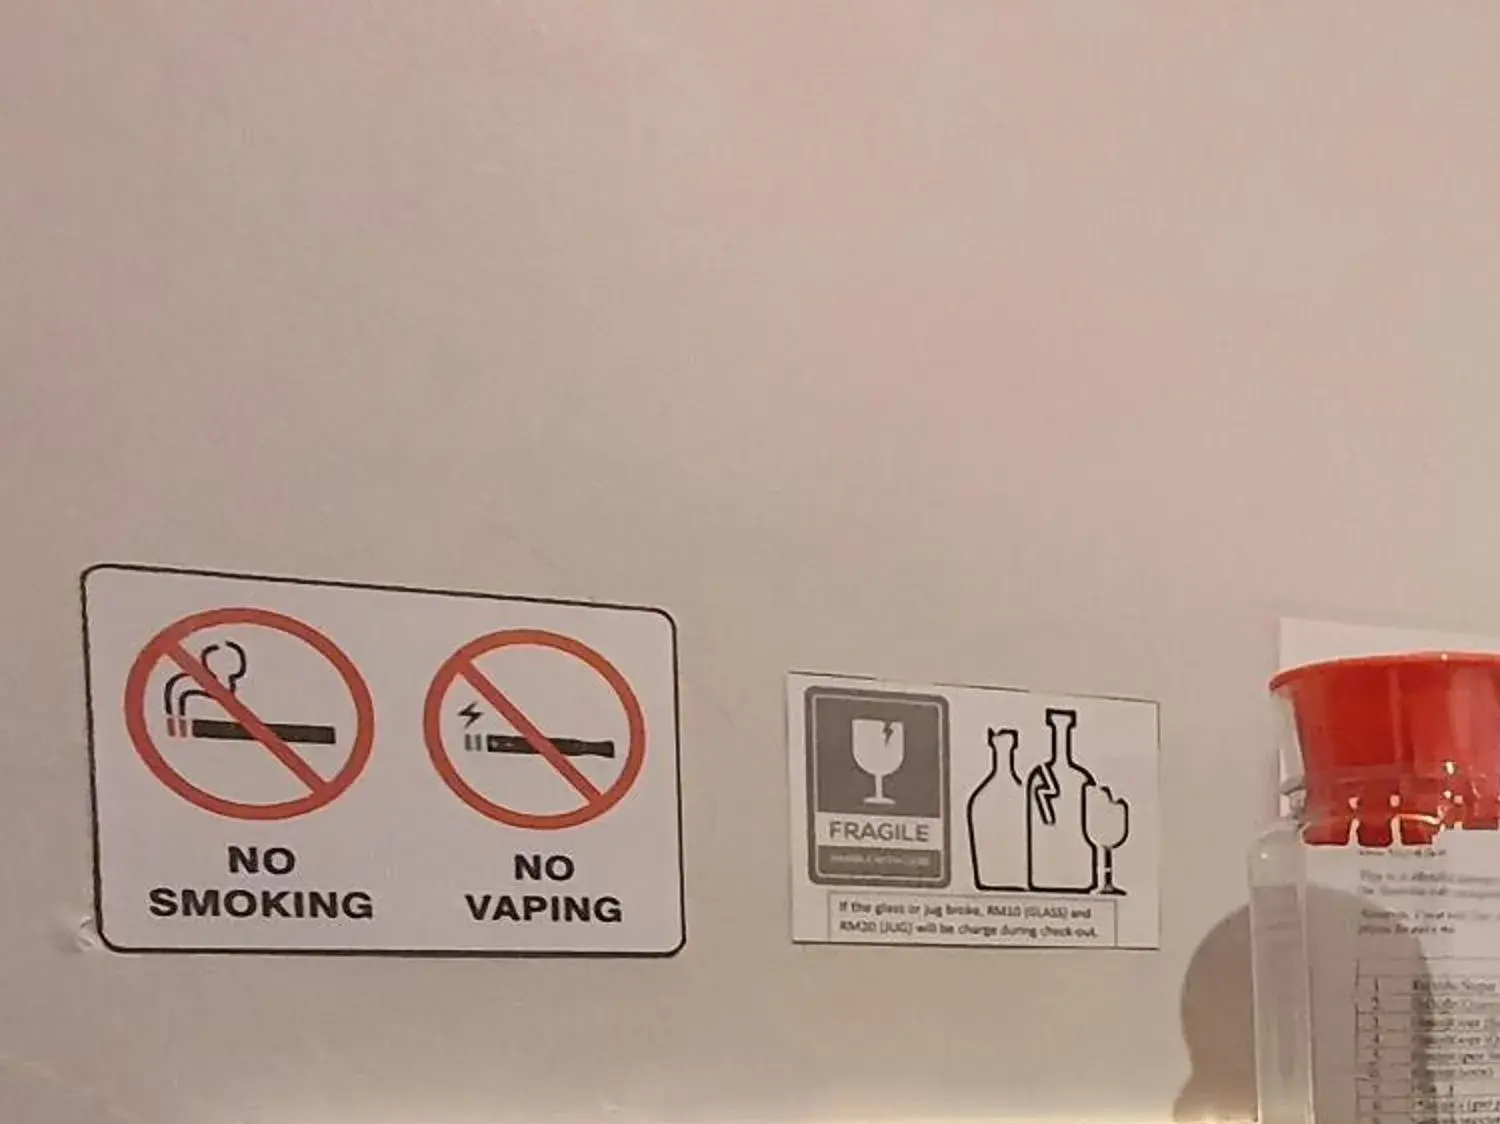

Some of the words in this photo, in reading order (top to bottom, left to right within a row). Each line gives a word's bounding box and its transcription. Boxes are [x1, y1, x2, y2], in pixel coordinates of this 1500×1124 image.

[829, 821, 930, 842] FRAGILE
[227, 845, 296, 875] NO
[514, 854, 575, 882] NO
[148, 887, 374, 920] SMOKING
[466, 893, 623, 923] VAPING
[839, 901, 847, 913] If
[851, 901, 872, 914] the
[875, 903, 905, 916] glass
[923, 904, 943, 918] jug
[1071, 907, 1092, 919] and
[916, 922, 938, 934] will
[939, 922, 955, 935] be
[958, 924, 998, 938] charge
[1001, 924, 1037, 939] during
